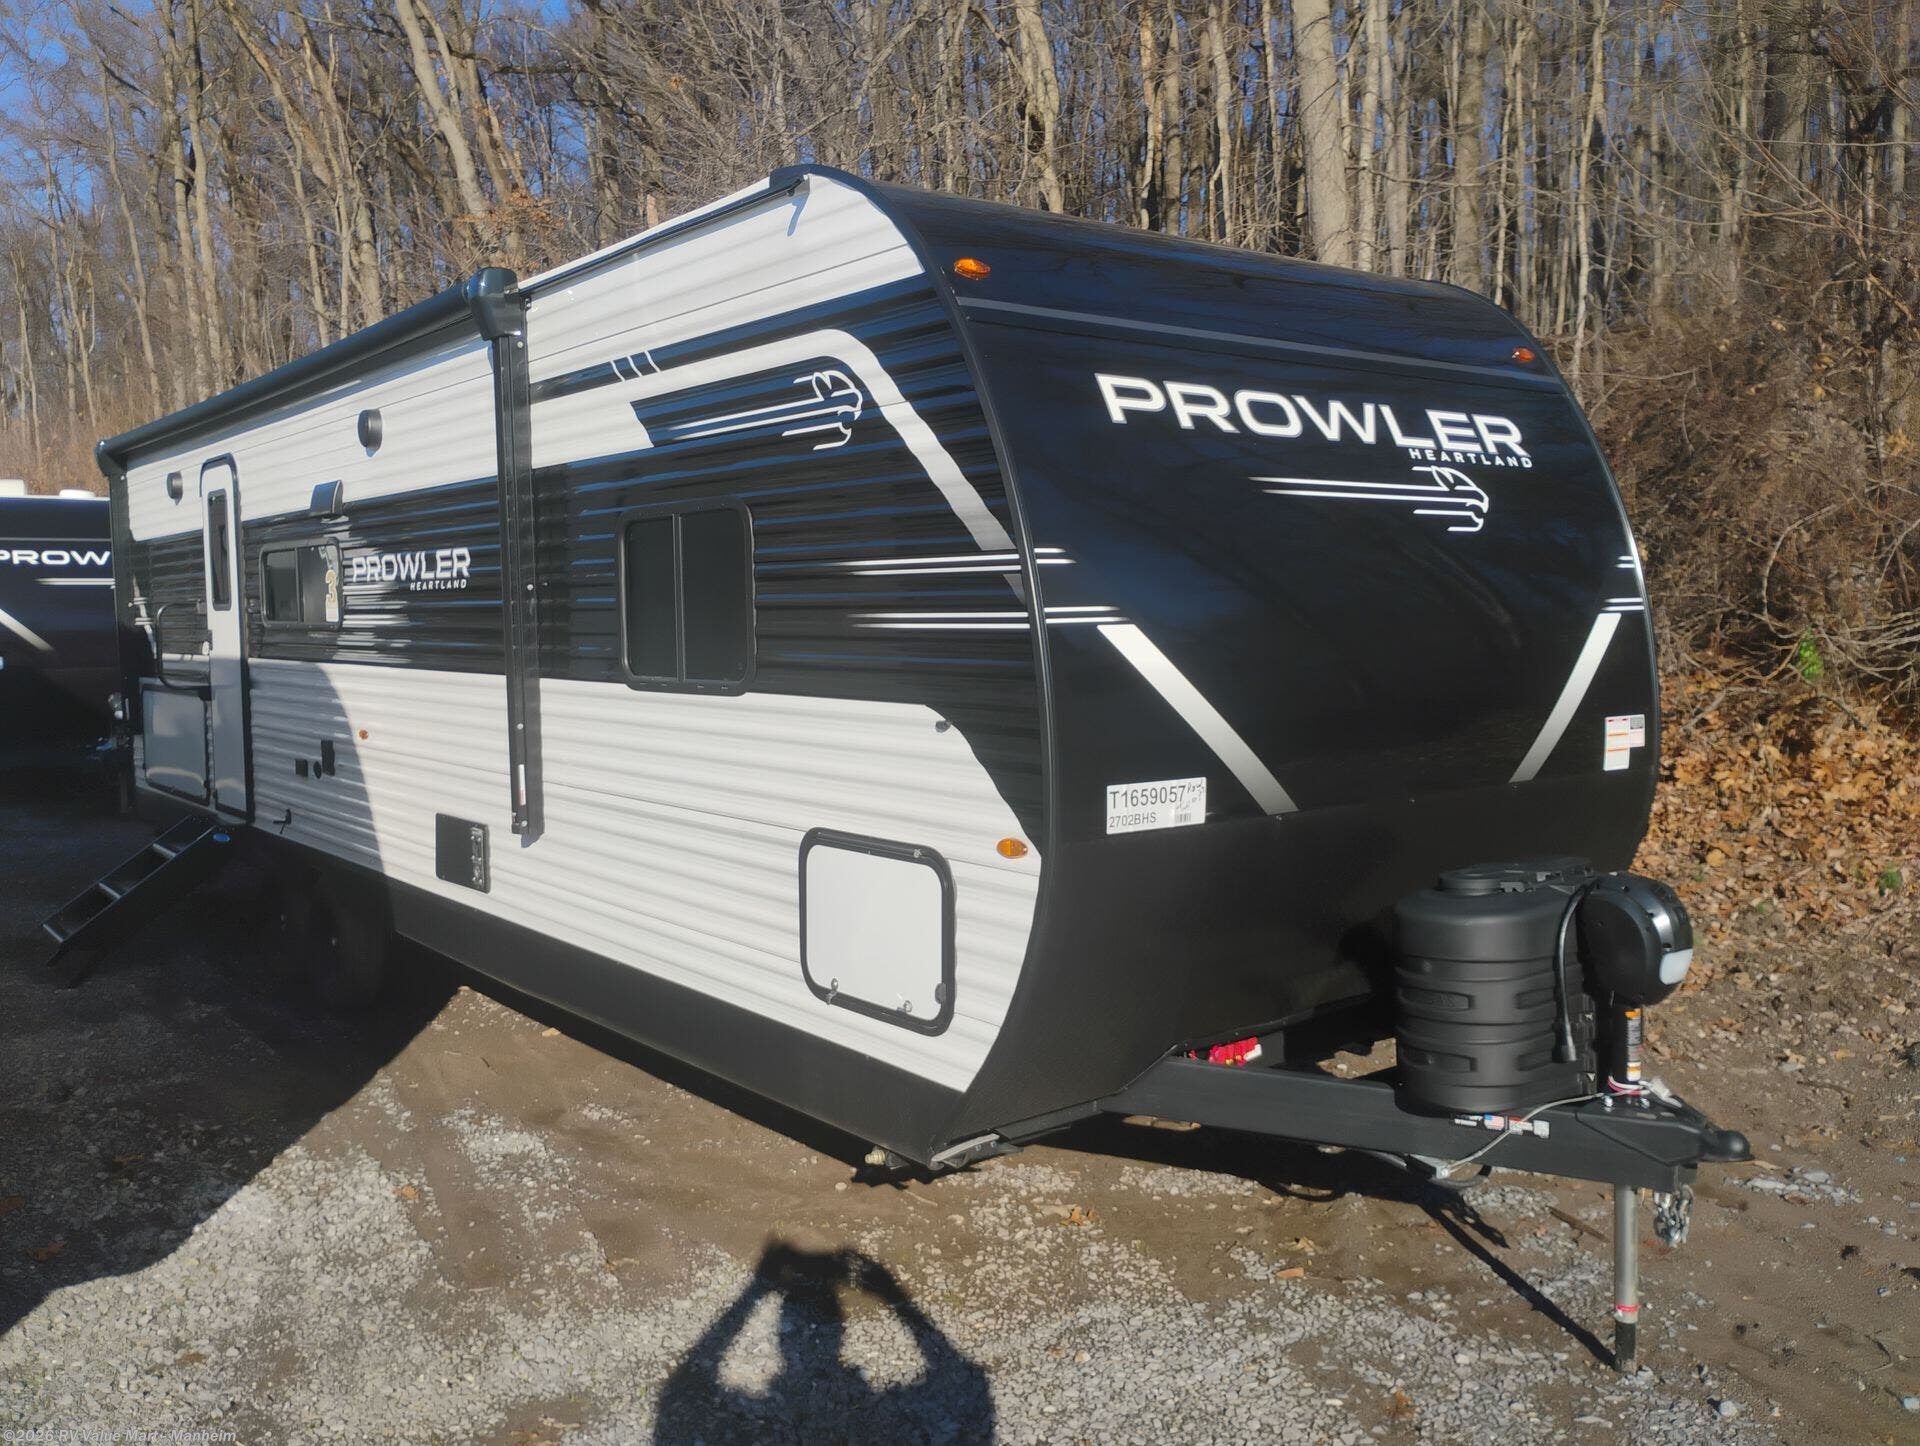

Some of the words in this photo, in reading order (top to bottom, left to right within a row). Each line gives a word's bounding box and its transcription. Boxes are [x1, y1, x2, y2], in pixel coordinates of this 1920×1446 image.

[1094, 373, 1531, 457] PROWLER
[1408, 448, 1533, 469] HEARTLAND
[352, 547, 471, 582] PROWLER
[409, 578, 467, 591] HEARTLAND
[1109, 785, 1186, 809] T1659057
[1108, 812, 1157, 828] 2702BHS
